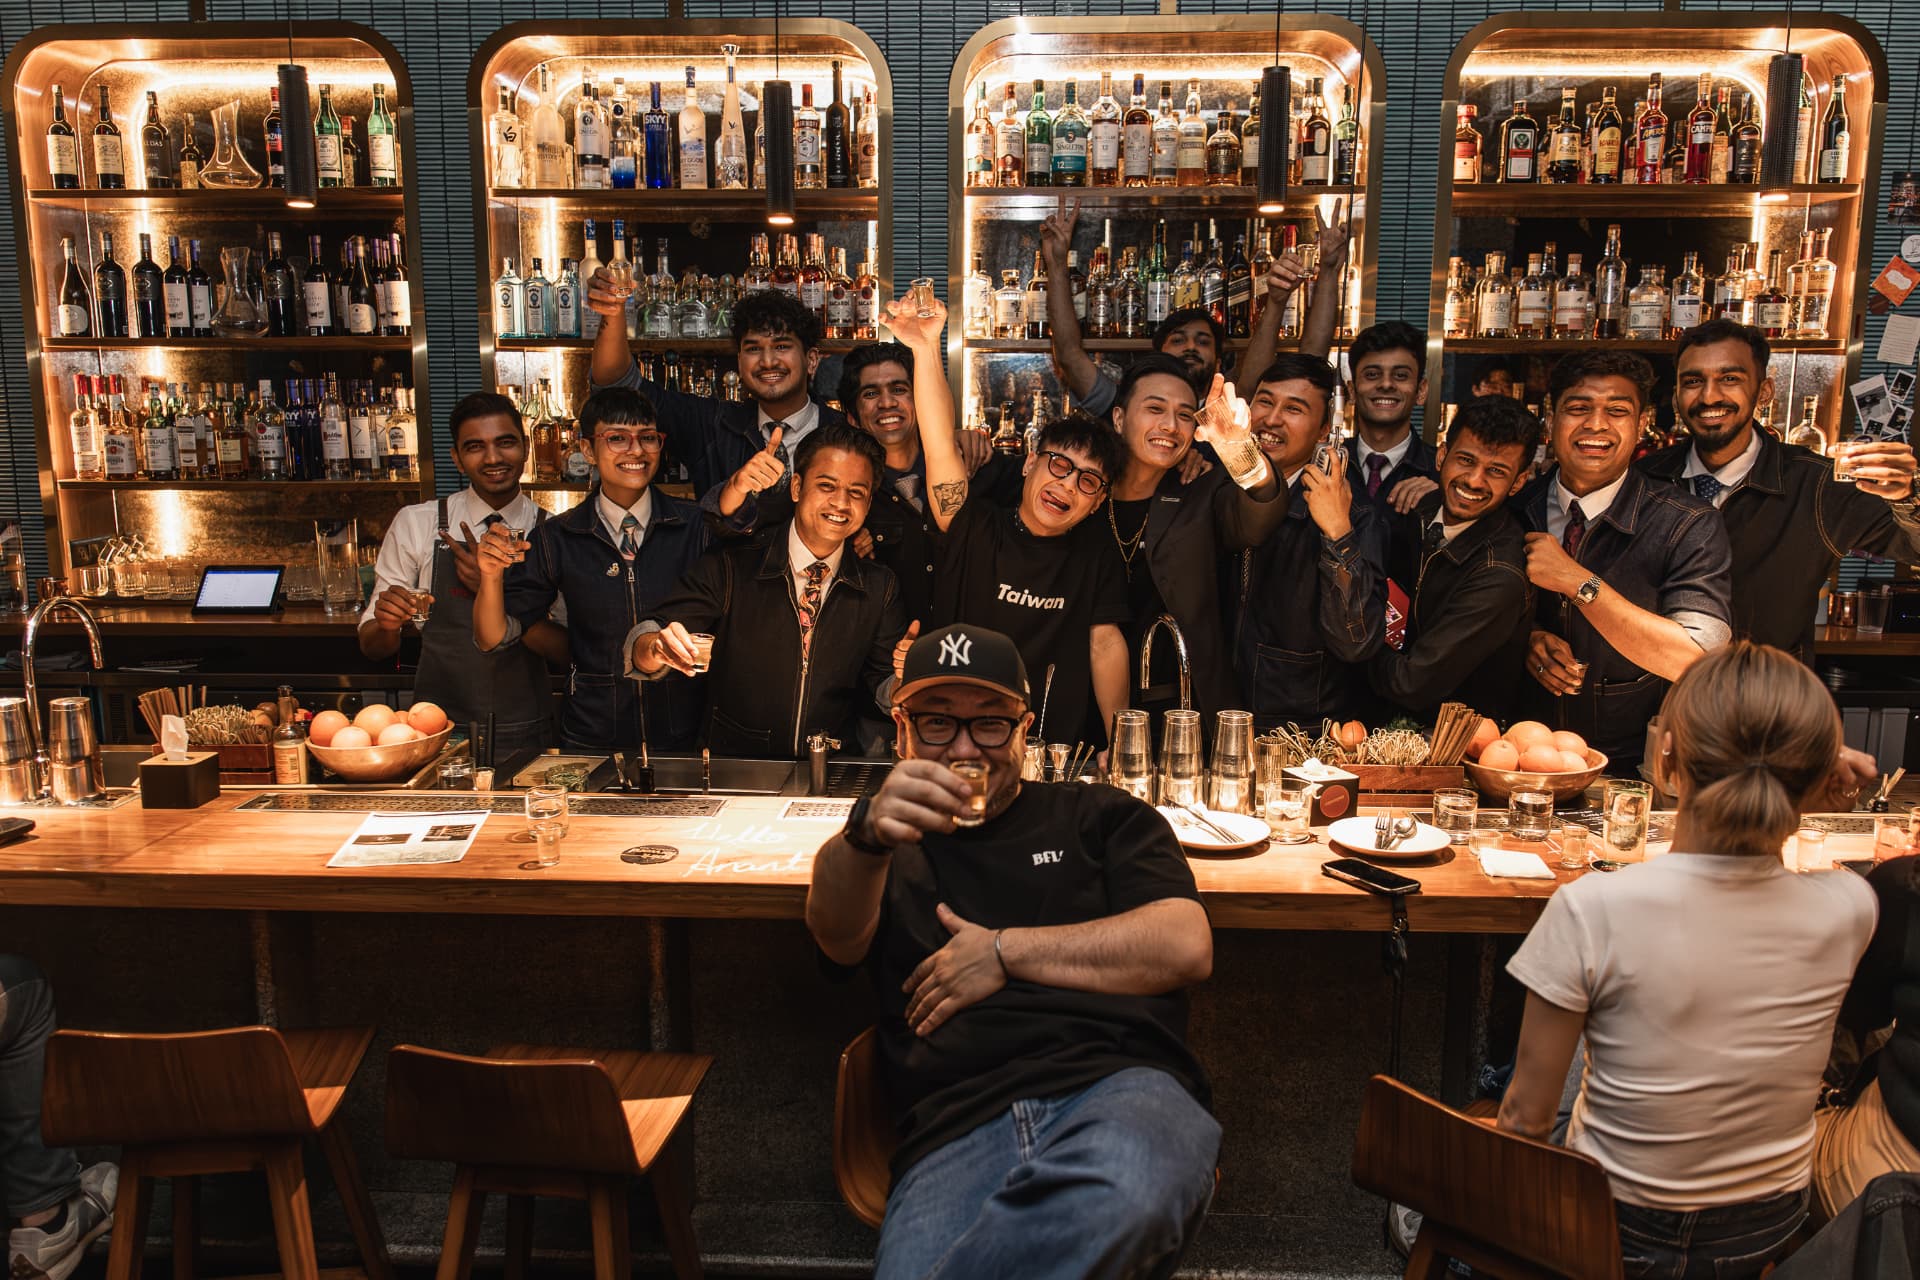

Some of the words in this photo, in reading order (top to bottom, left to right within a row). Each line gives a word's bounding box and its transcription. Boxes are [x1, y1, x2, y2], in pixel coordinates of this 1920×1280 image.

[645, 115, 666, 124] SKYY
[503, 126, 517, 142] 白
[1057, 161, 1065, 169] 12
[998, 583, 1065, 609] Taiwan
[938, 632, 973, 666] NY
